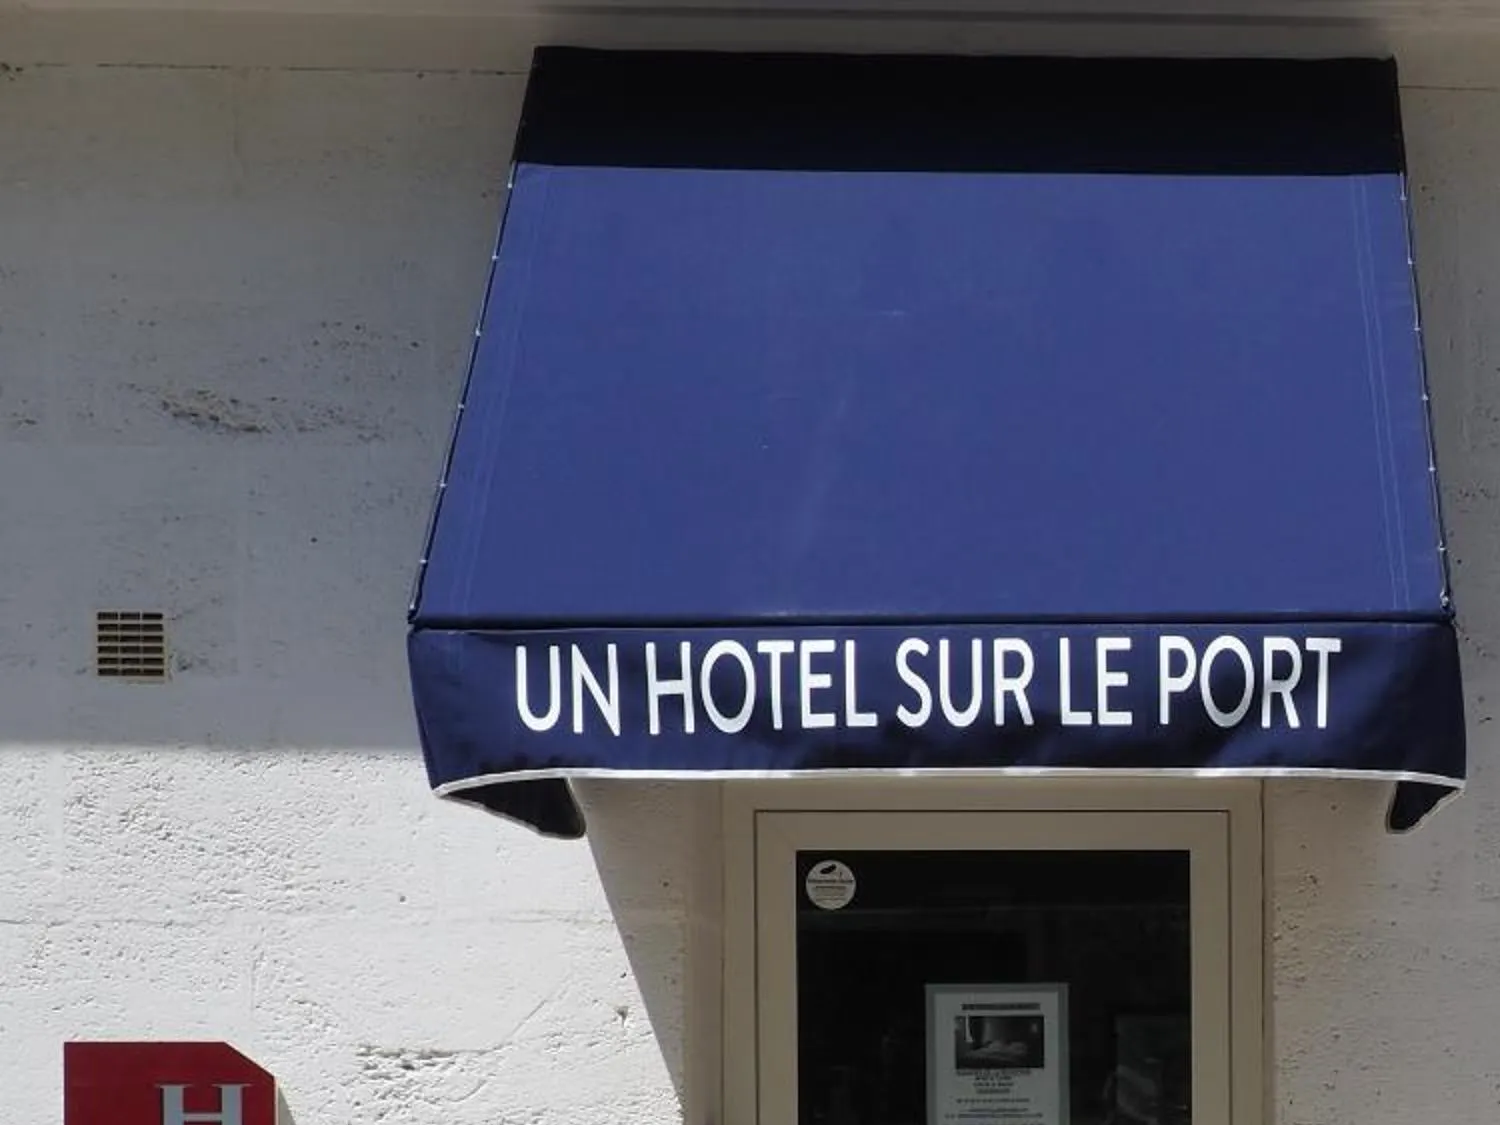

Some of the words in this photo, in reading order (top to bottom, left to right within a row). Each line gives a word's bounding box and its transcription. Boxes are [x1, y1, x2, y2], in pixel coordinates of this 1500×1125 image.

[515, 643, 621, 737] UN
[645, 639, 878, 736] HOTEL
[895, 637, 1035, 728] SUR
[1059, 636, 1133, 726] LE
[1159, 635, 1342, 729] PORT
